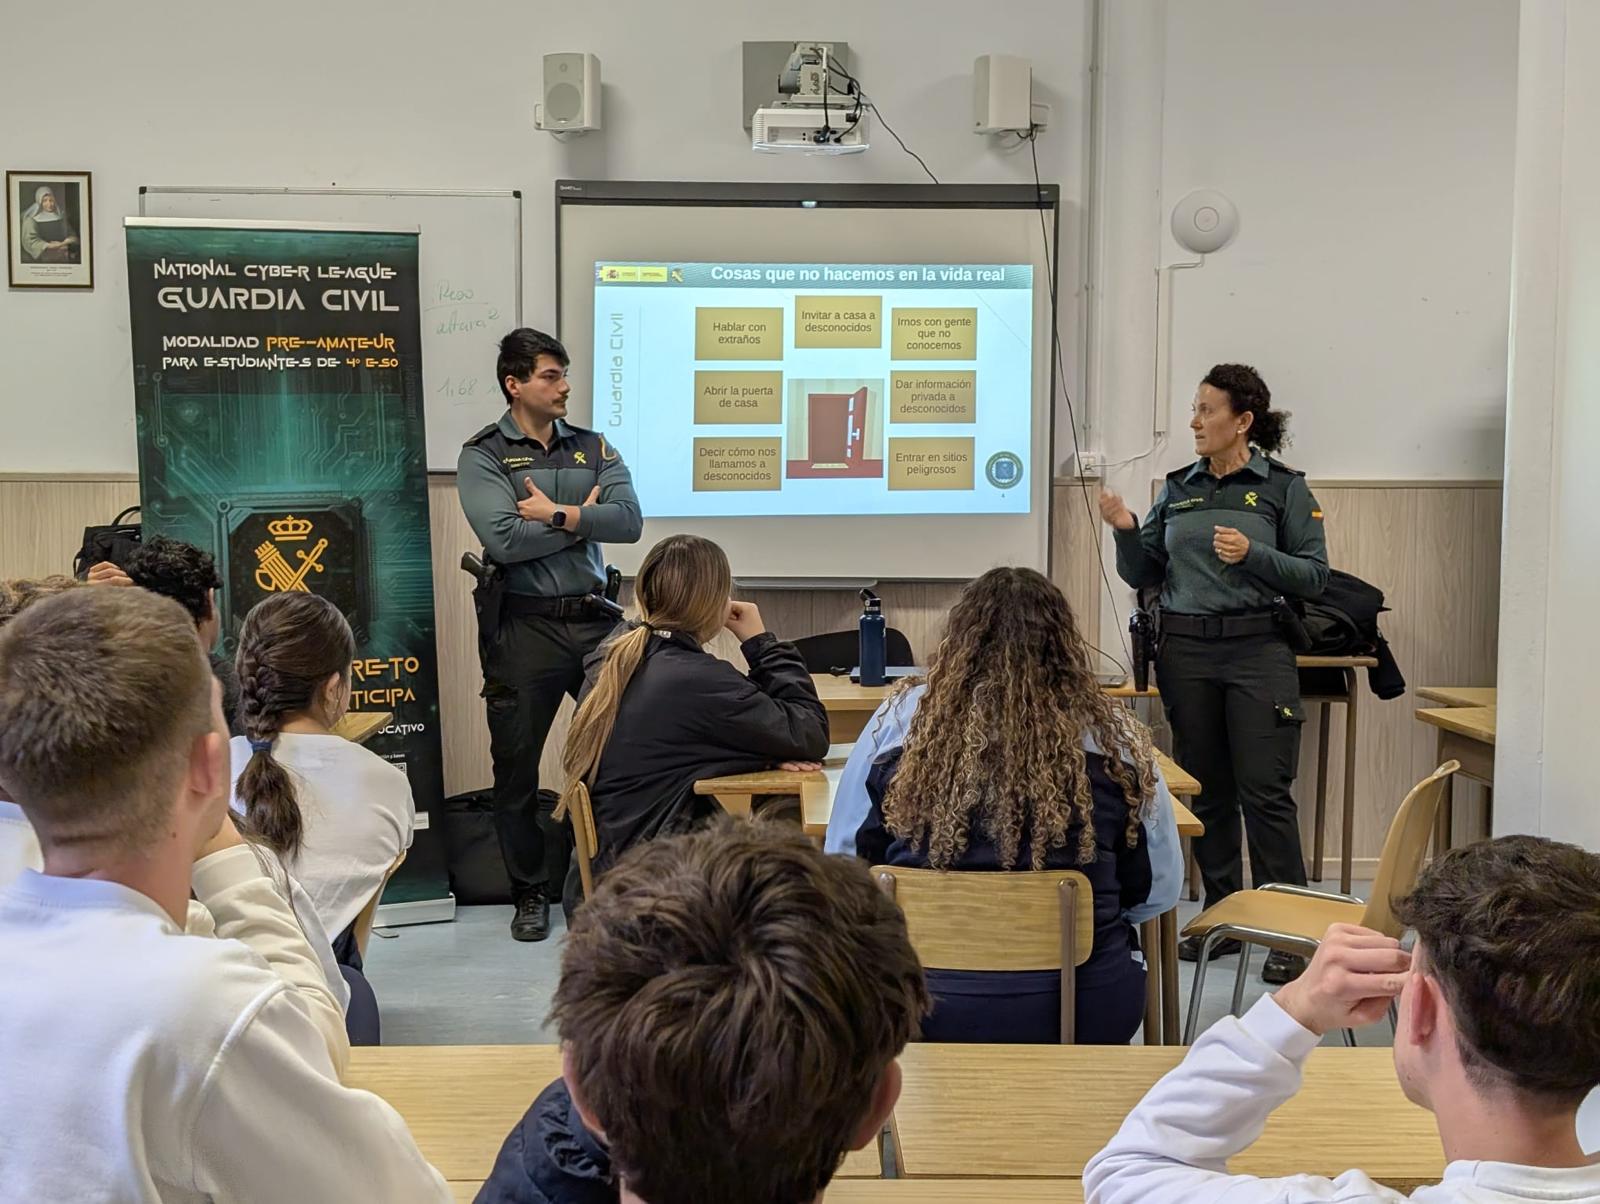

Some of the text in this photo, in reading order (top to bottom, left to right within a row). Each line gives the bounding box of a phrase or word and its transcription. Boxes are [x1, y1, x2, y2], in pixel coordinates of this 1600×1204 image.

[153, 258, 397, 283] NATIONAL CYBER LEAGUE
[711, 266, 1005, 284] Cosas que no hacemos en la vida real
[157, 286, 400, 312] GUARDIA CIVIL
[801, 310, 876, 320] Invitar a casa a
[713, 322, 767, 332] Hablar con
[805, 322, 872, 332] desconocidos
[924, 318, 942, 326] con
[944, 318, 972, 328] gente
[718, 334, 761, 344] extraños
[917, 330, 951, 339] que no
[162, 335, 259, 351] MODALIDAD
[906, 341, 962, 350] conocemos
[162, 356, 198, 370] PARA
[203, 354, 312, 370] ESTUDIANTES
[317, 357, 341, 368] DE
[365, 358, 399, 368] ESO
[895, 379, 972, 389] Dar información
[608, 354, 623, 427] Guardia
[704, 386, 774, 398] Abrir la puerta
[911, 392, 956, 403] privada a
[718, 398, 758, 408] de casa
[900, 404, 967, 414] desconocidos
[699, 447, 777, 457] Decir cómo nos
[895, 452, 968, 462] Entrar en sitios
[709, 459, 766, 469] llamamos a
[906, 464, 957, 476] peligrosos
[703, 471, 772, 481] desconocidos
[352, 656, 420, 682] RETO
